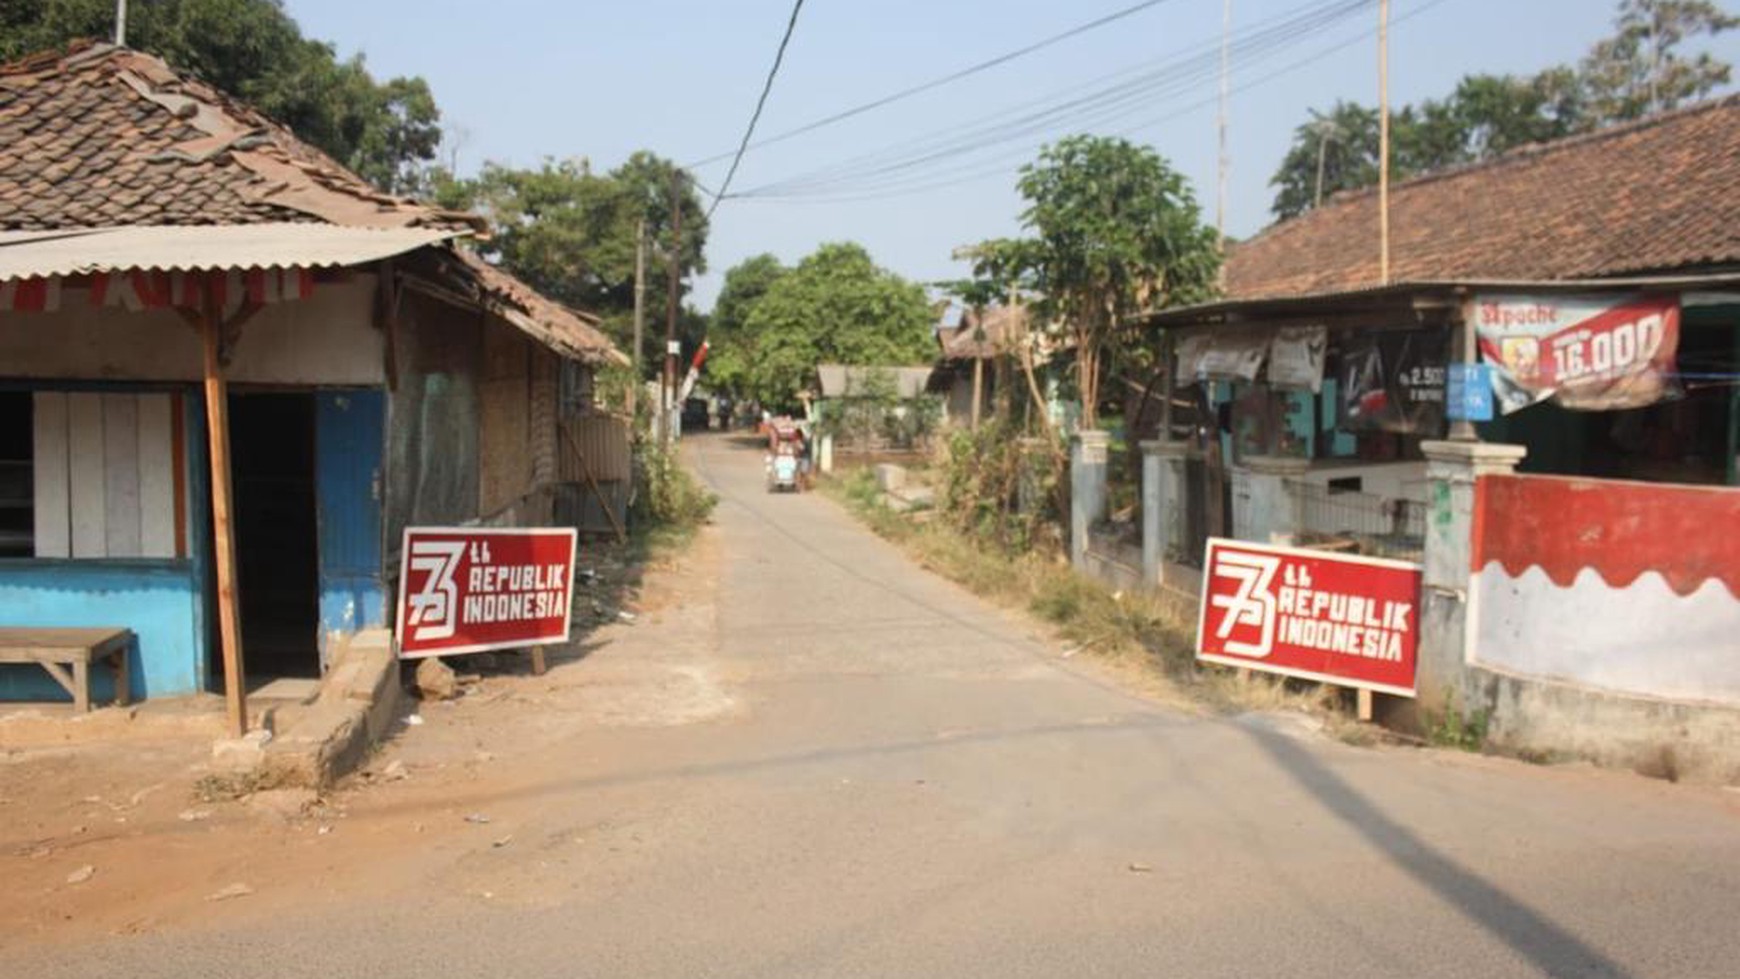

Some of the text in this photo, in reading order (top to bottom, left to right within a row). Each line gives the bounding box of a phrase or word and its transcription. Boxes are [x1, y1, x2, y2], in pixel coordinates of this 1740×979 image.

[408, 541, 467, 641] 73
[469, 564, 564, 592] REPUBLIK
[463, 591, 564, 624] INDONESIA
[1212, 551, 1281, 658] 73
[1278, 586, 1413, 632] REPUBLIK
[1278, 615, 1403, 662] INDONESIA
